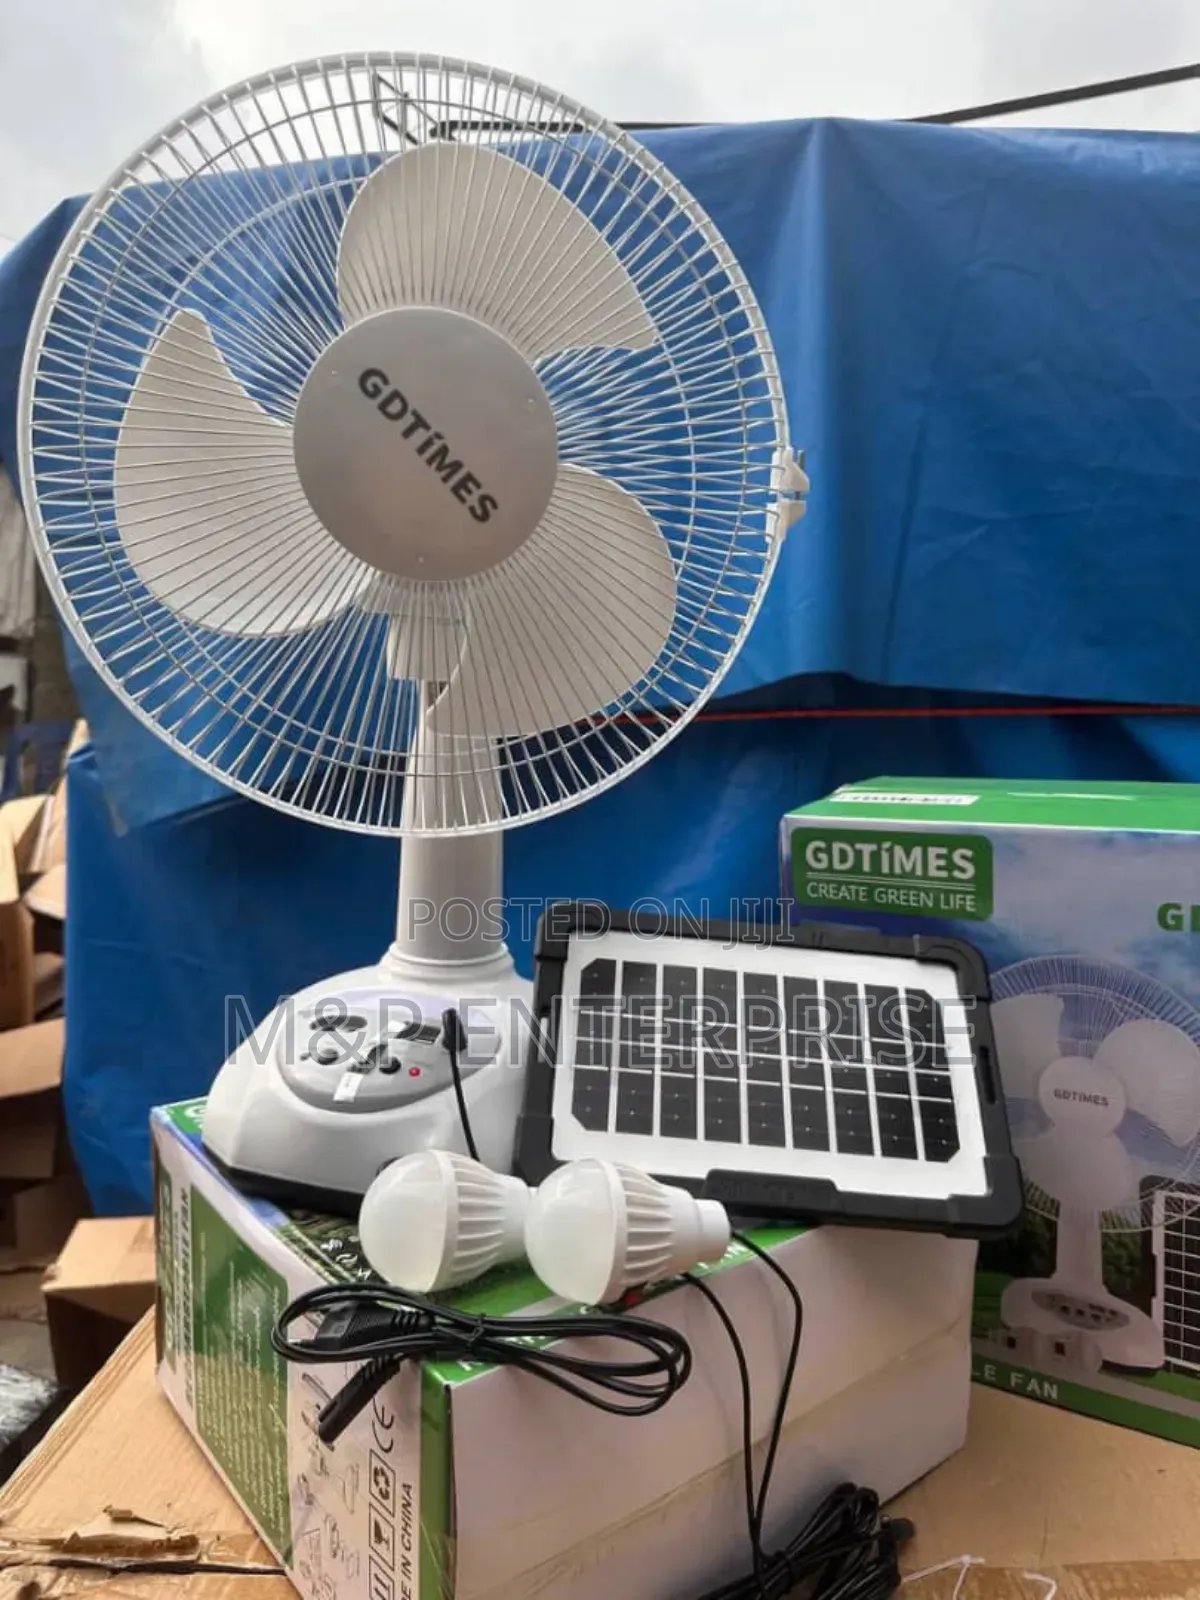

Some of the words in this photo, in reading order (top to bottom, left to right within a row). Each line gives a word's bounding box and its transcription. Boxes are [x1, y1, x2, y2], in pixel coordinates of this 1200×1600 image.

[806, 881, 868, 902] CREATE
[874, 887, 933, 908] GREEN
[940, 893, 977, 913] LIFE
[1009, 1371, 1058, 1400] FAN
[401, 1483, 413, 1552] CHINA
[401, 1555, 412, 1580] IN
